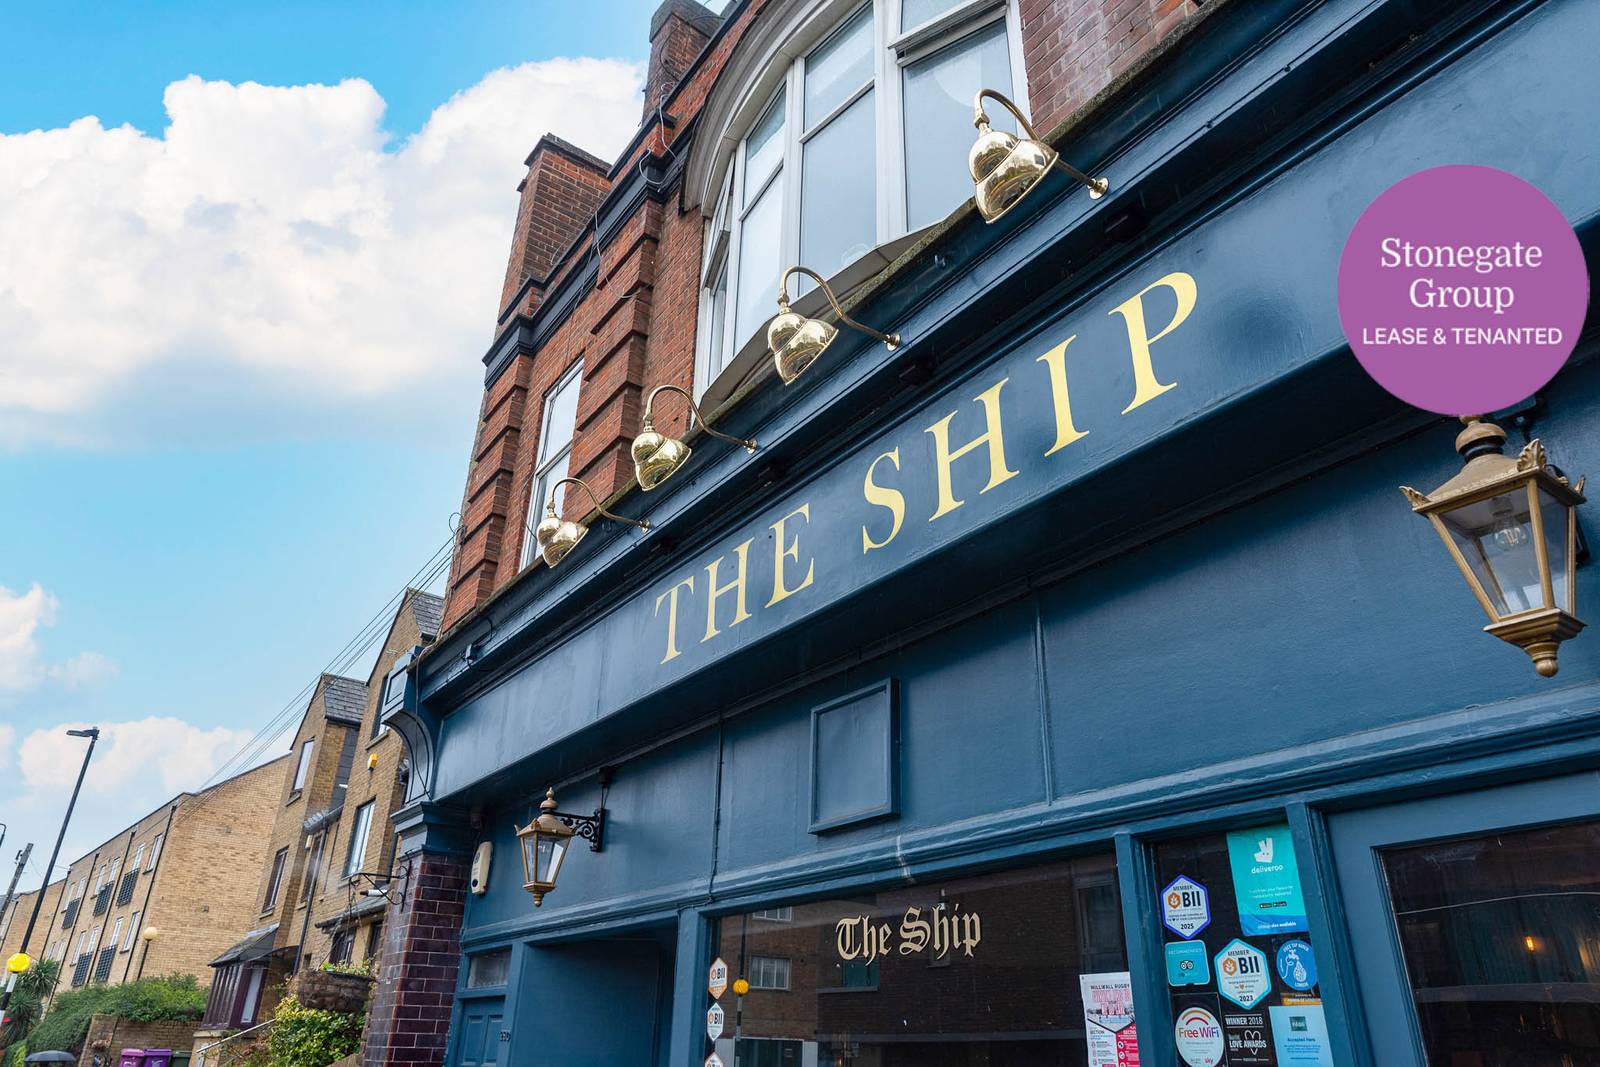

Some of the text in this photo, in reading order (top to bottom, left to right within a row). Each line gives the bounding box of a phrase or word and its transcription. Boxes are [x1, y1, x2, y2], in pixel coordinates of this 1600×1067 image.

[654, 271, 1199, 665] THE SHIP
[1251, 864, 1284, 874] deliveroo
[1182, 891, 1201, 908] BII
[835, 903, 982, 967] The Ship
[1238, 956, 1260, 974] BII
[1225, 1016, 1264, 1025] WINNER 2018
[1177, 1027, 1198, 1038] Free
[1199, 1026, 1220, 1038] WiFi
[1229, 1040, 1267, 1048] LOVE AWARDS
